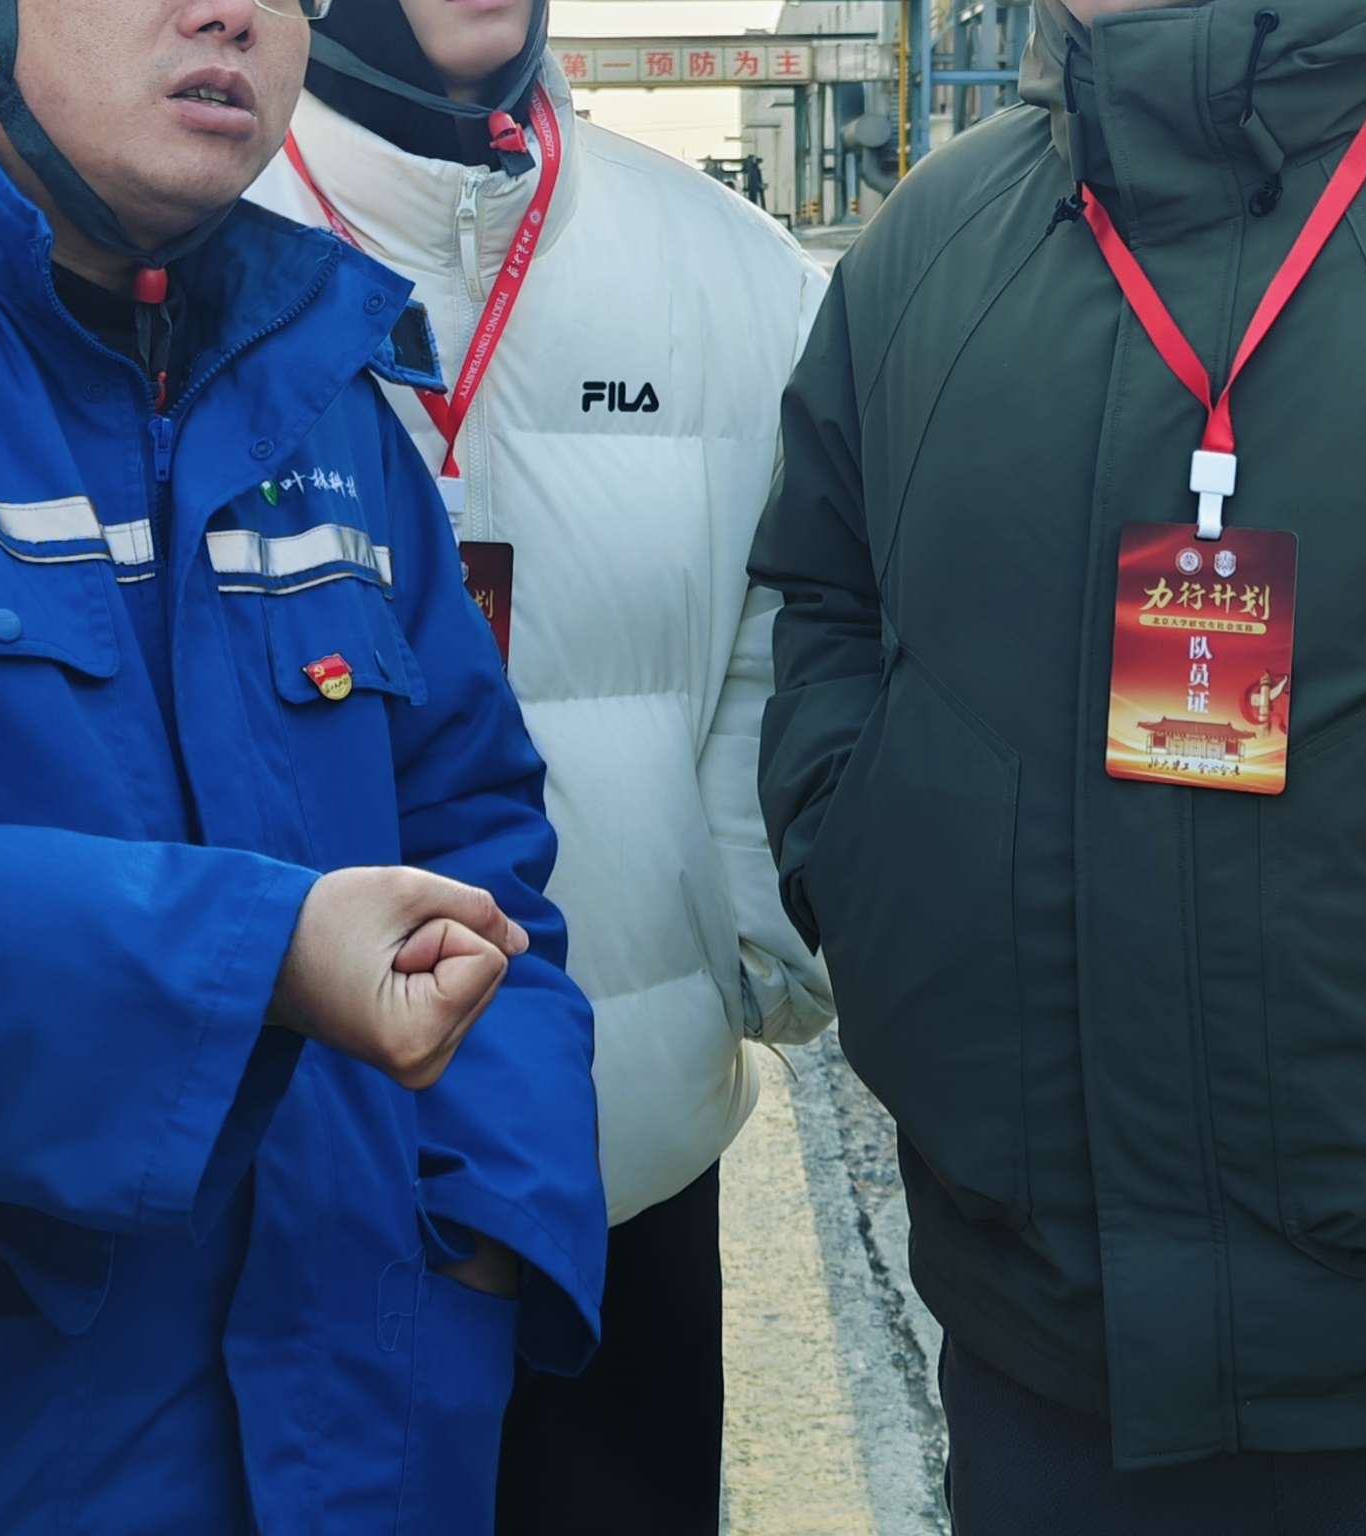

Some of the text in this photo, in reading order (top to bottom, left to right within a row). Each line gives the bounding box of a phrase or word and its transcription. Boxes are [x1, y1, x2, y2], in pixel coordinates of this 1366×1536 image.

[561, 50, 803, 79] 第一预防为主
[459, 291, 509, 399] PEKING UNIVERSITY
[582, 381, 659, 413] FILA
[1139, 577, 1270, 620] 力行计划
[1186, 636, 1213, 714] 队员证
